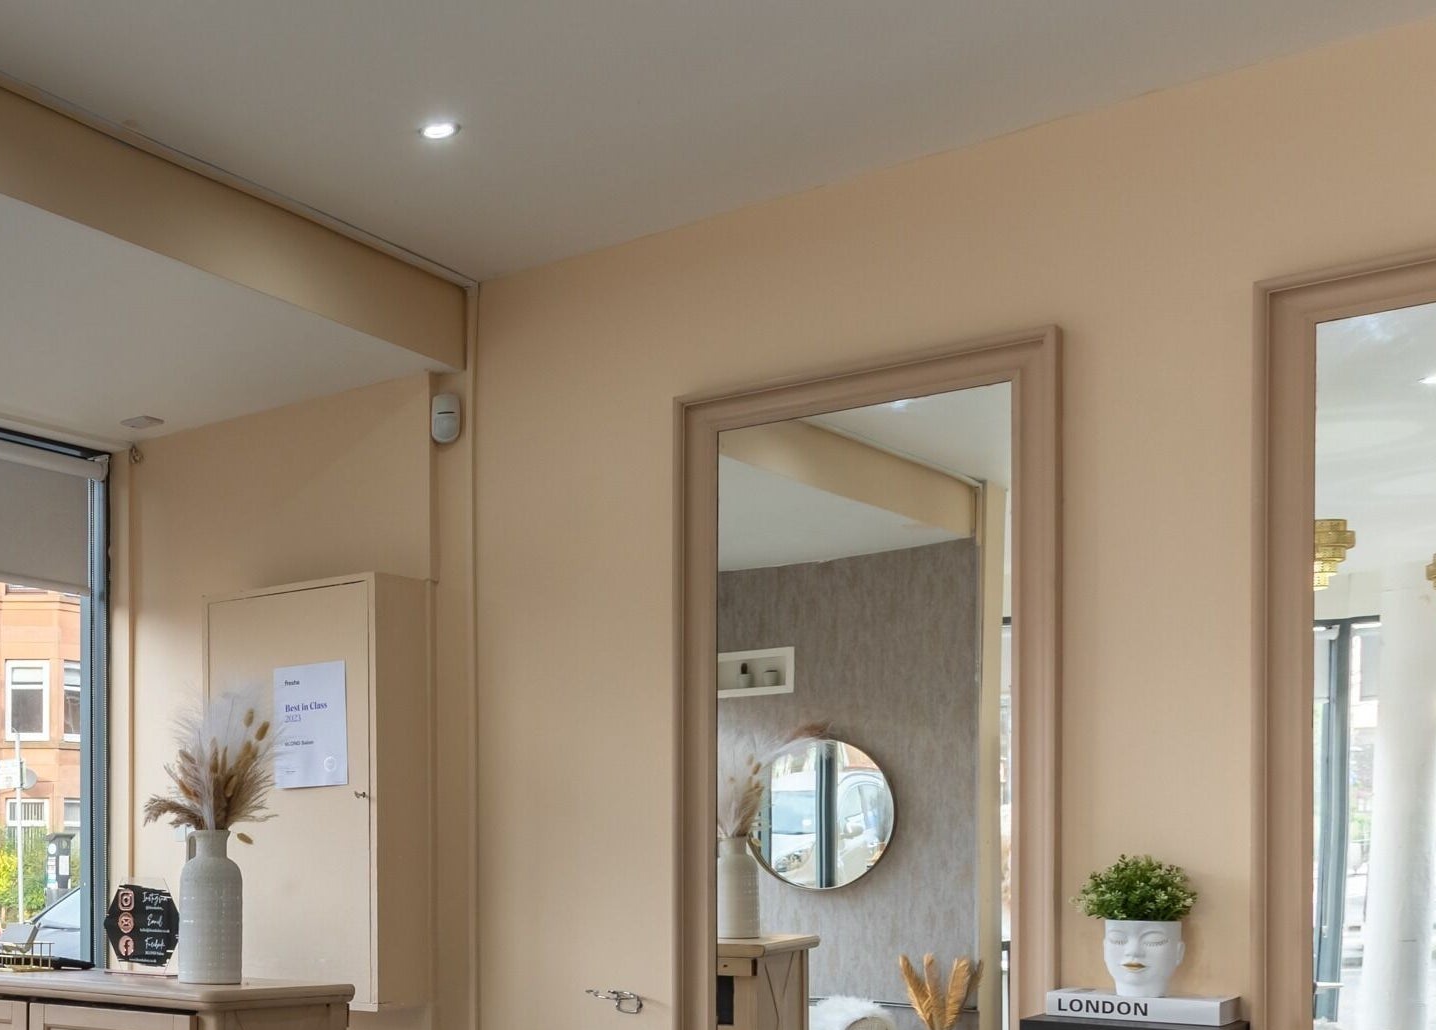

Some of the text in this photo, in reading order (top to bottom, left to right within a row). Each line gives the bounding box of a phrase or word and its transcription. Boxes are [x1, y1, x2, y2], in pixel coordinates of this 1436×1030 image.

[285, 701, 328, 713] Best in Class
[1057, 998, 1149, 1017] LONDON
